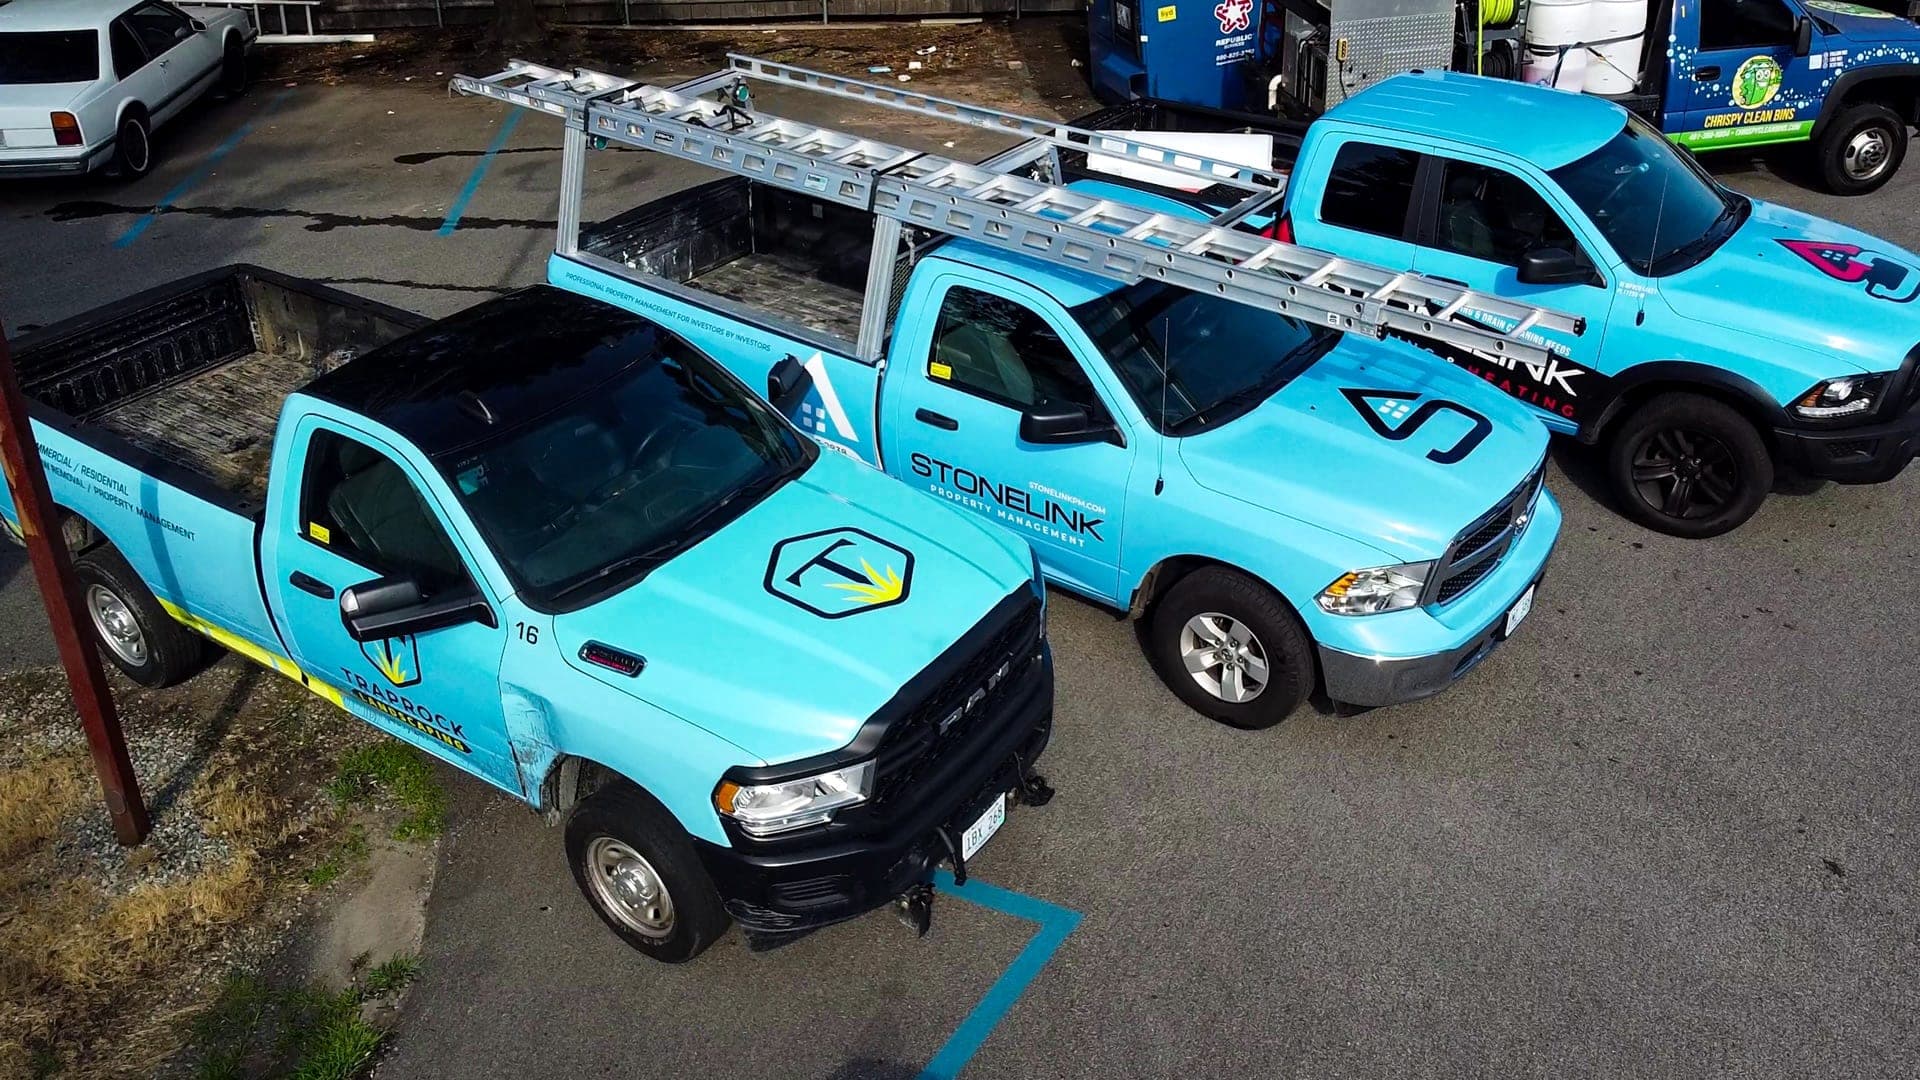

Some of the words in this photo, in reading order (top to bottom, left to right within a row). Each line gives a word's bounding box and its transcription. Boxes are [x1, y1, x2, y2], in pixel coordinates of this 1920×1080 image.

[1215, 33, 1253, 47] REPUBLIC
[1704, 112, 1744, 128] CHRISPY
[1744, 109, 1773, 124] CLEAN
[1773, 107, 1796, 121] BINS
[566, 272, 606, 292] PROFESSIONAL
[605, 287, 635, 302] PROPERTY
[635, 297, 679, 319] MANAGEMENT
[677, 312, 690, 324] FOR
[691, 317, 725, 337] INVESTORS
[725, 329, 735, 338] BY
[735, 333, 771, 352] INVESTORS
[1481, 313, 1507, 329] DRAIN
[1506, 322, 1544, 346] CANING
[1545, 338, 1572, 357] NEEDS
[37, 442, 72, 469] MMERCIAL
[81, 465, 129, 496] RESIDENTIAL
[50, 464, 85, 489] REMOVAL
[93, 486, 134, 513] PROPERTY
[136, 506, 195, 541] MANAGEMENT
[911, 452, 1105, 543] STONELINK
[930, 484, 992, 513] PROPERTY
[997, 509, 1086, 548] MANAGEMENT
[1029, 481, 1107, 515] STONELINKPM.COM
[515, 621, 539, 645] 16
[340, 667, 468, 740] TRAPROCK
[358, 692, 465, 751] LANDSCAPING
[939, 661, 1010, 736] RAM
[966, 825, 983, 853] 1BX
